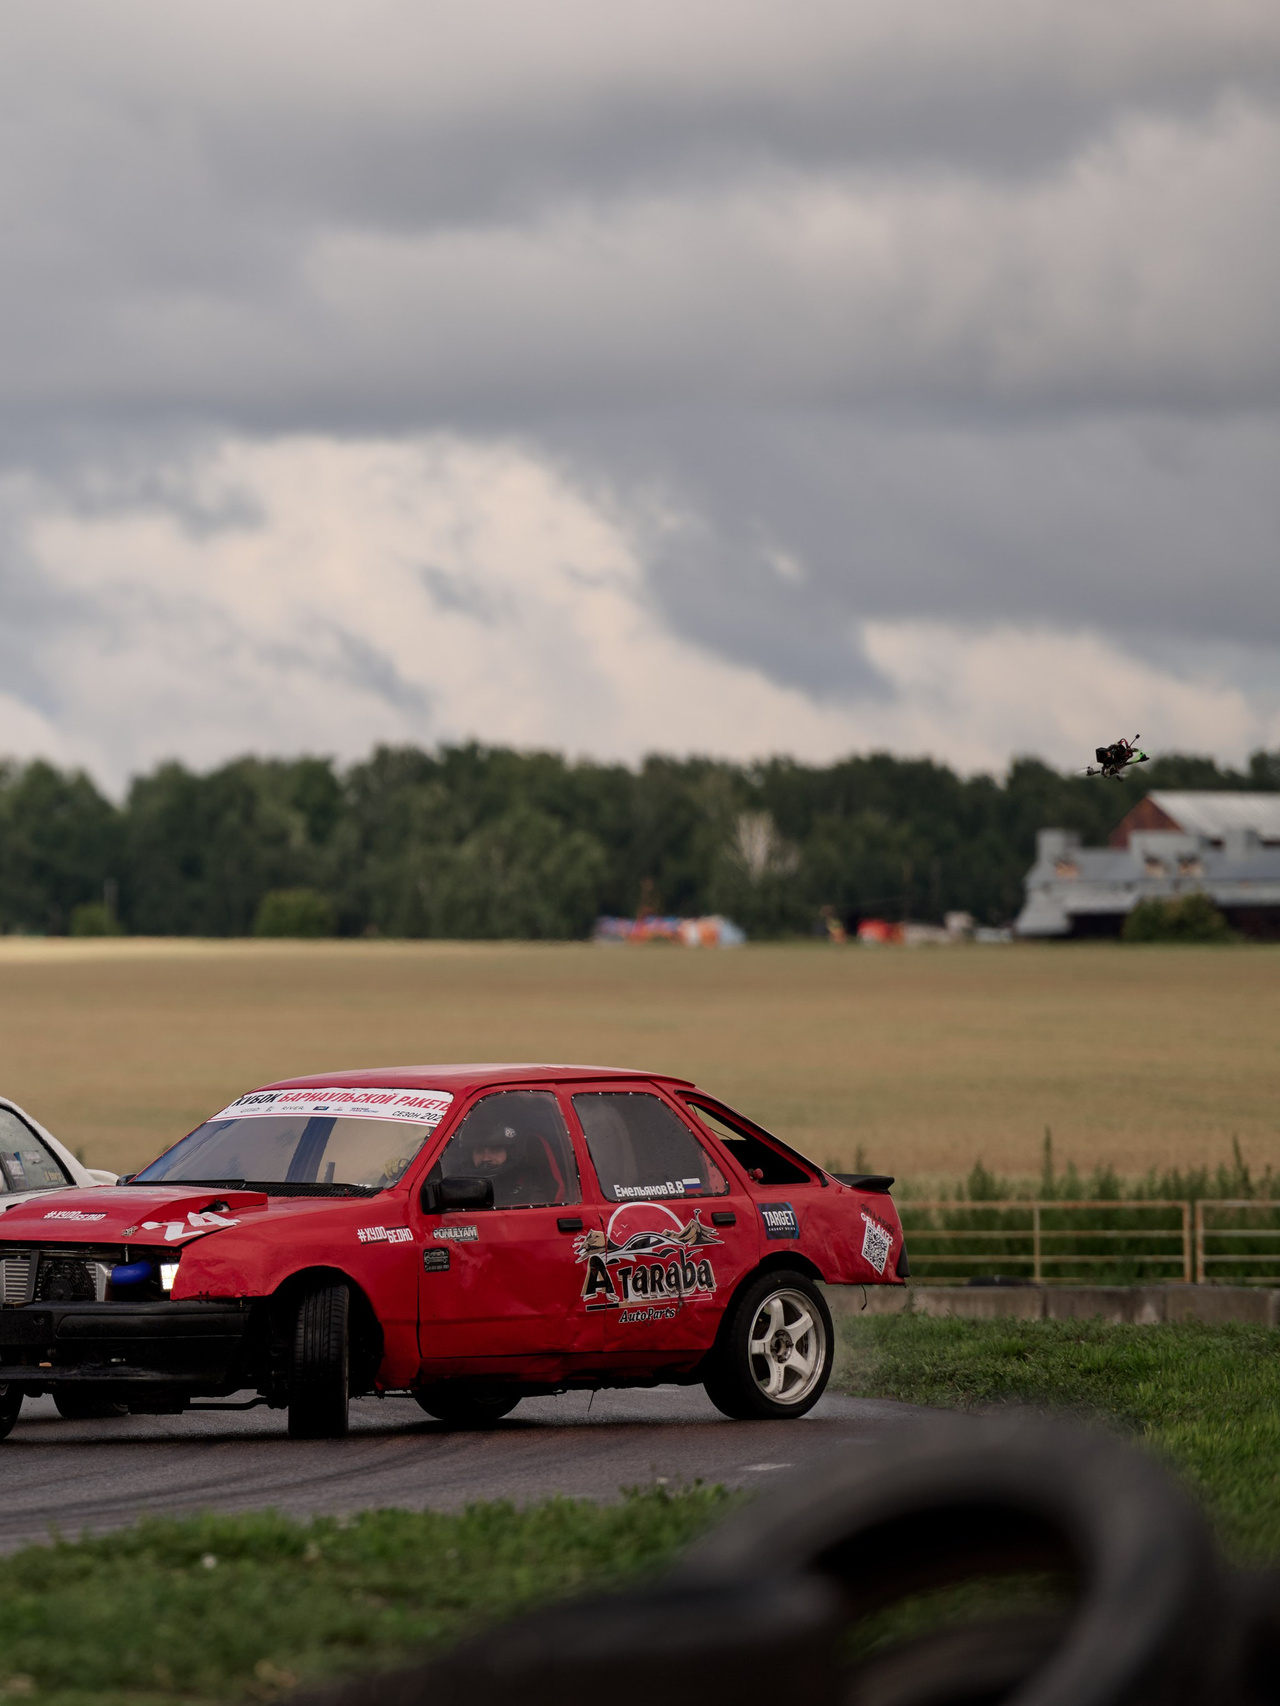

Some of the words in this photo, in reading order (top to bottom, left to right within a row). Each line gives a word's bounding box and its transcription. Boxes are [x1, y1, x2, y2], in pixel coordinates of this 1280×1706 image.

[231, 1093, 282, 1107] КУБОК
[277, 1092, 398, 1105] БАРНАУЛЬСКОЙ
[762, 1210, 795, 1227] TARGET
[386, 1228, 413, 1243] БЕДНО
